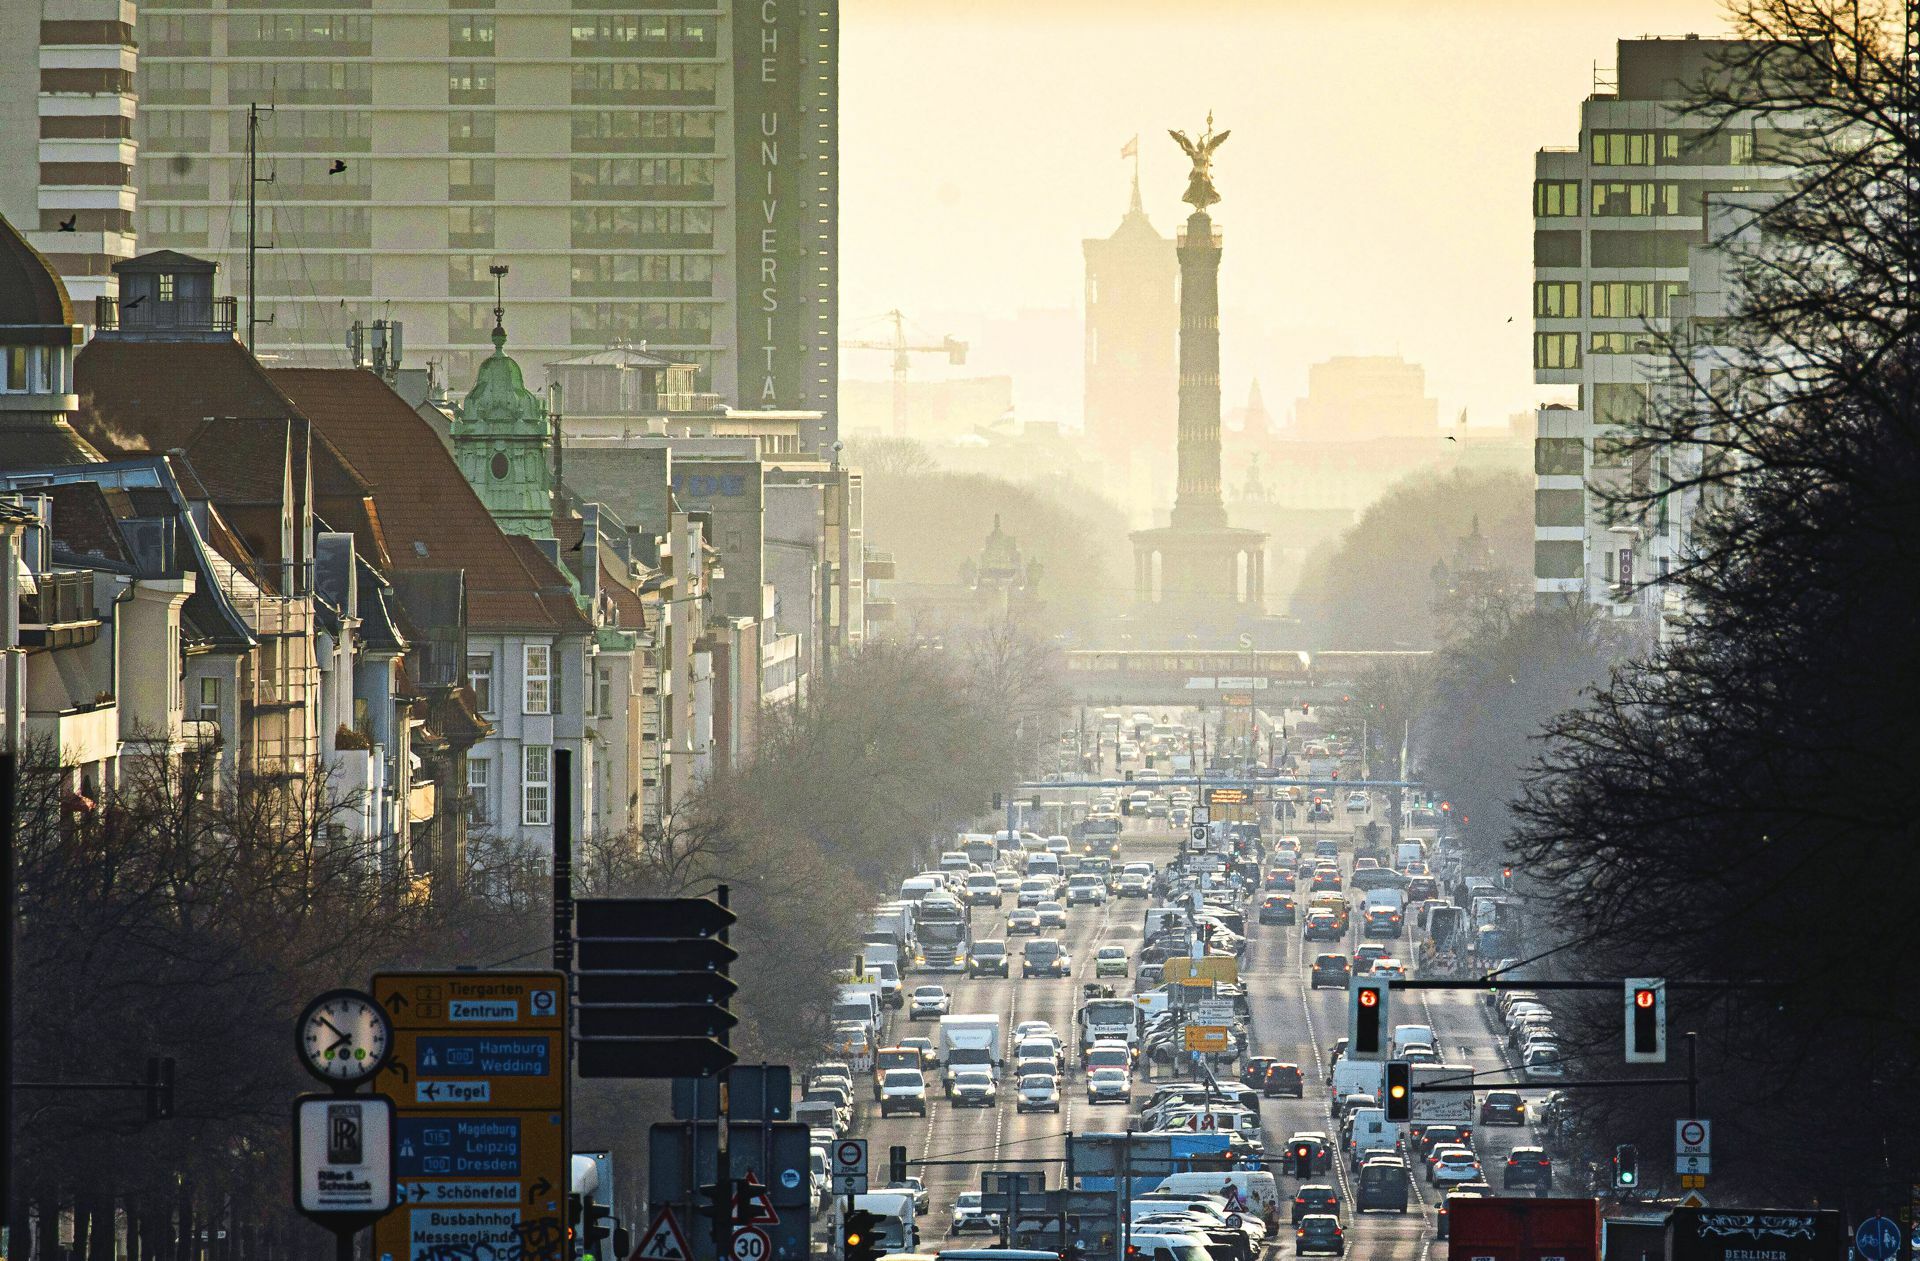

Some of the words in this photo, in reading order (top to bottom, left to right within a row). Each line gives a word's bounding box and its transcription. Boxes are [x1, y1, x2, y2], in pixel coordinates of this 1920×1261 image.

[761, 113, 777, 411] UNIVERSITÄ
[449, 983, 524, 998] Tiergarten
[453, 1004, 514, 1017] Zentrum
[450, 1051, 470, 1062] 100
[479, 1042, 546, 1057] Hamburg
[480, 1059, 543, 1074] Wedding
[447, 1085, 486, 1100] Tegel
[457, 1123, 518, 1138] Magdeburg
[427, 1132, 446, 1143] 115
[466, 1140, 518, 1156] Leipzig
[427, 1159, 446, 1170] 100
[456, 1158, 518, 1171] Dresden
[436, 1185, 518, 1200] Schönefeld
[430, 1212, 516, 1227] Busbahnhof
[413, 1230, 517, 1246] Messegelände
[737, 1238, 761, 1258] 30
[1725, 1249, 1786, 1261] BERLINER
